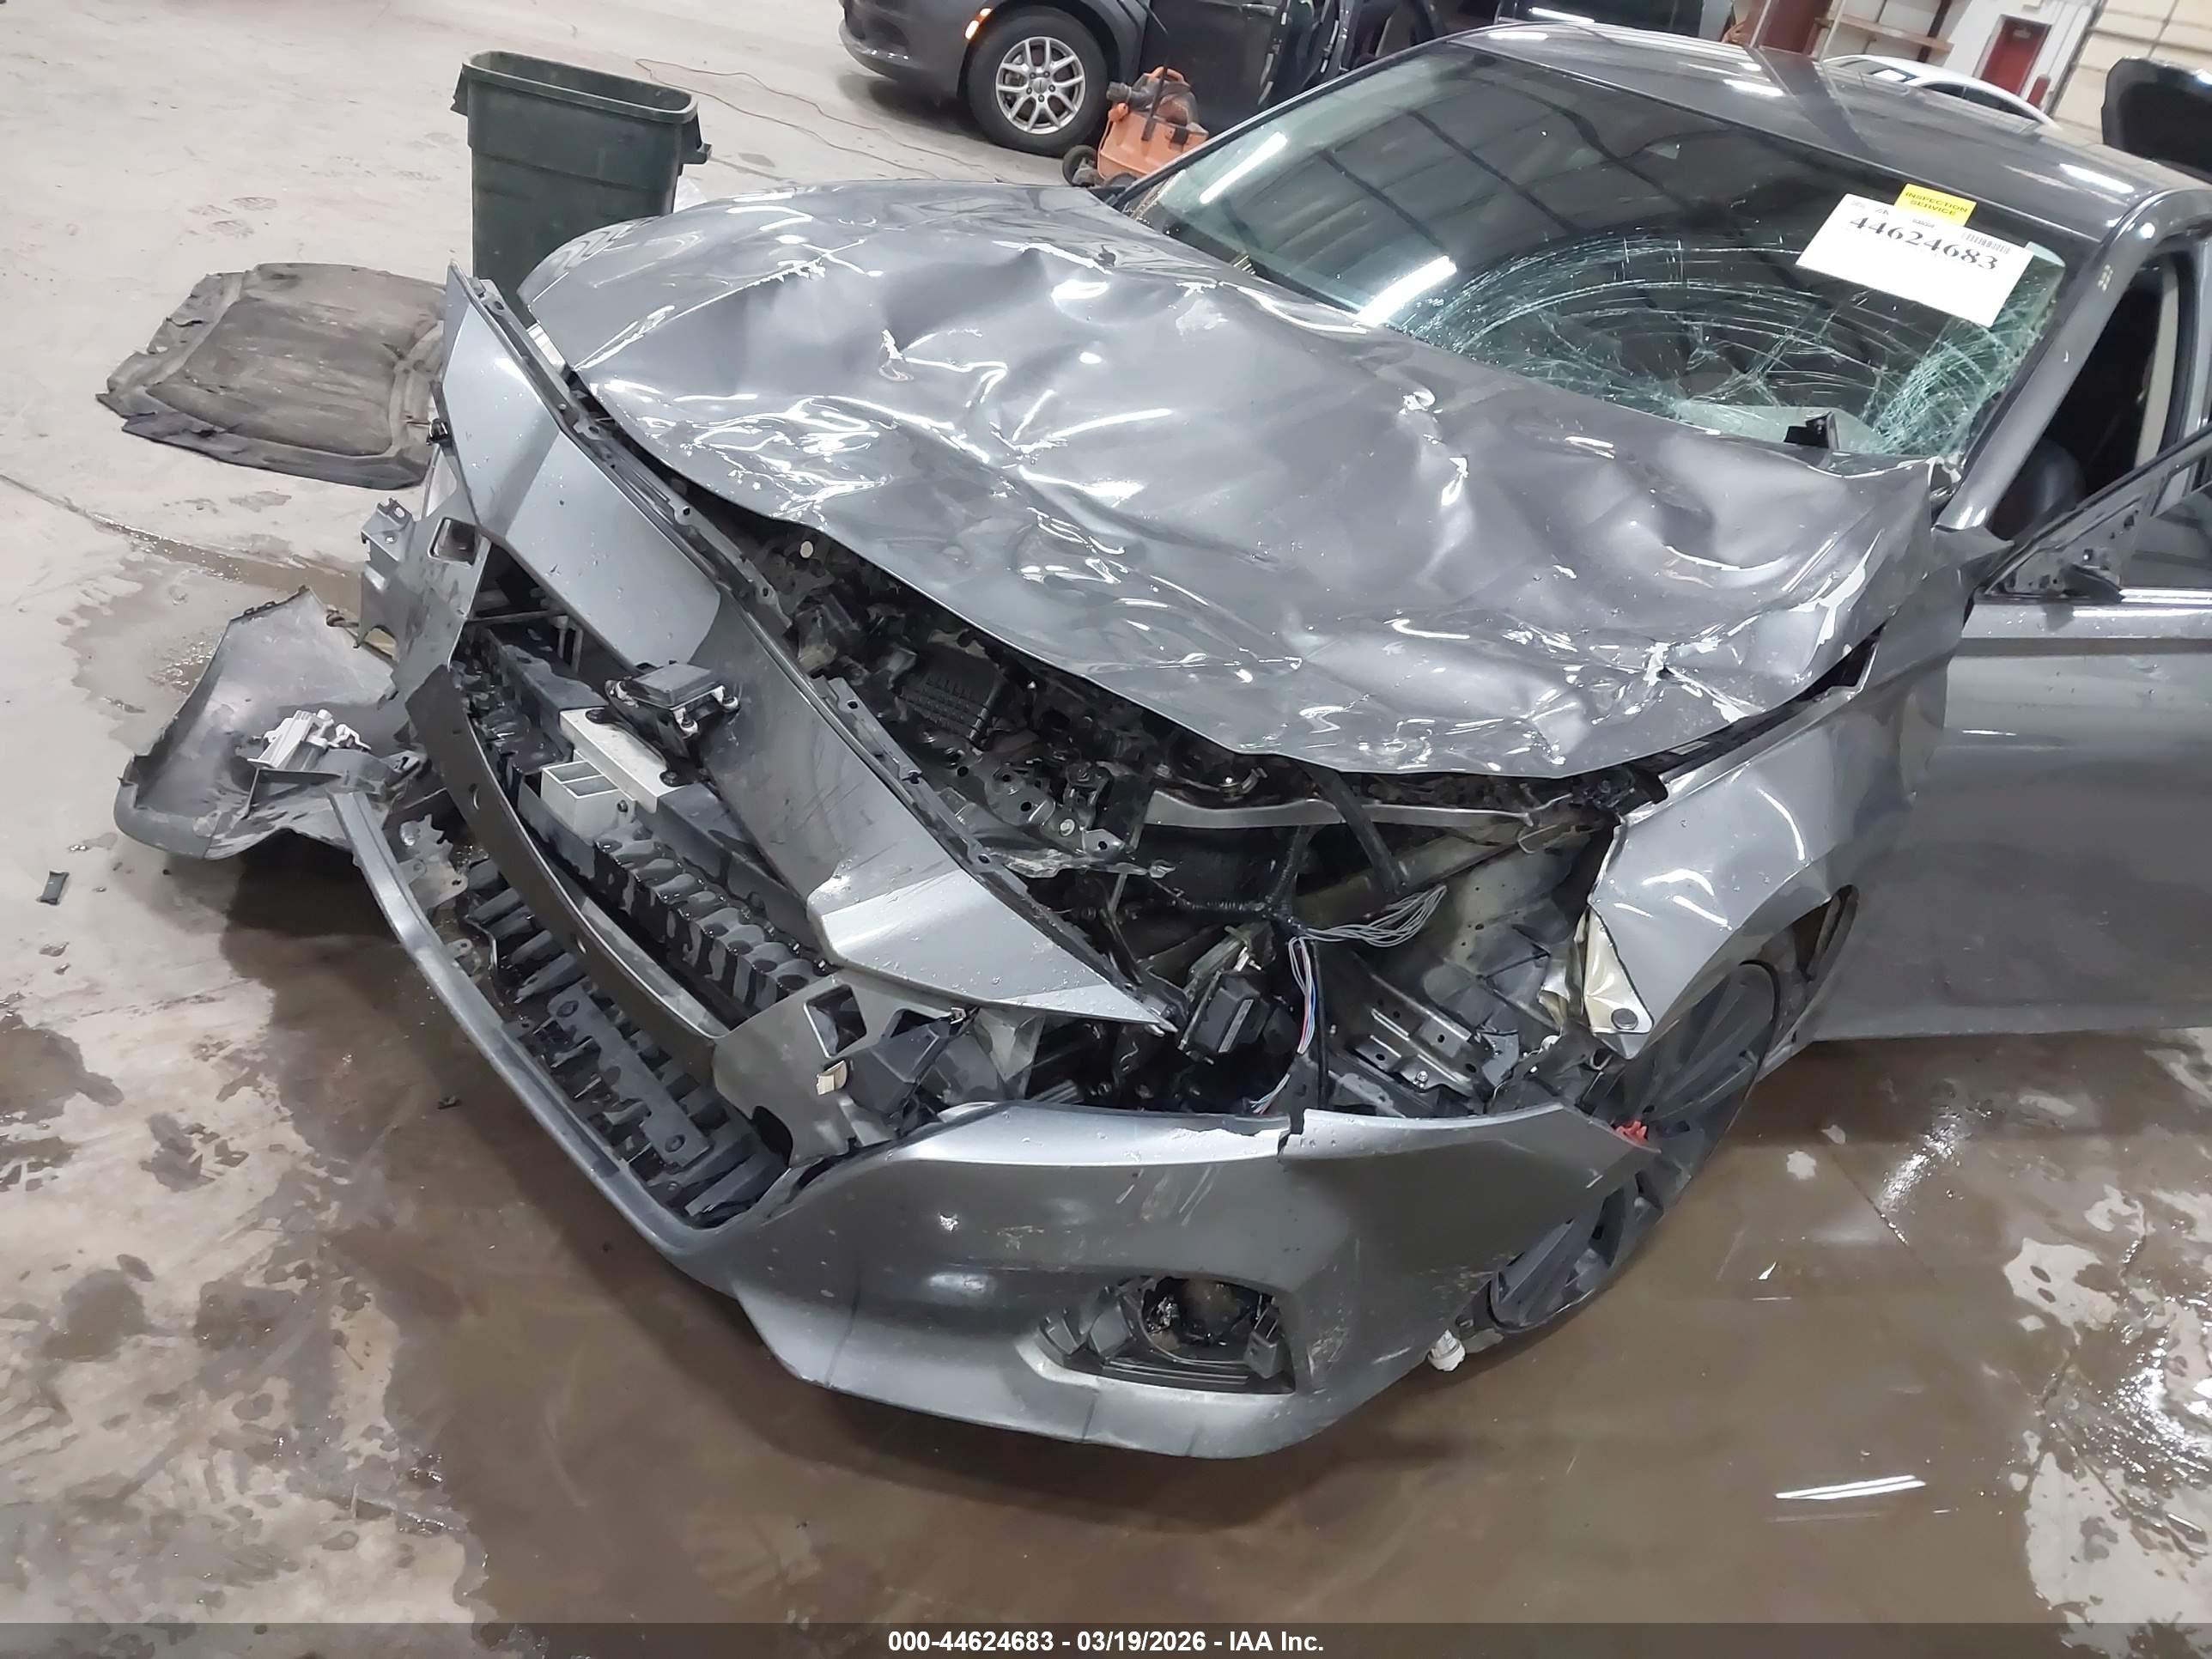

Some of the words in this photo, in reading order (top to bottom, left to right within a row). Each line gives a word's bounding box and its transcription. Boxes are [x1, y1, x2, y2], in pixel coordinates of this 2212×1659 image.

[1905, 191, 1968, 213] INSPECTION
[1910, 199, 1957, 216] SERVICE
[1850, 216, 1998, 270] 44624683
